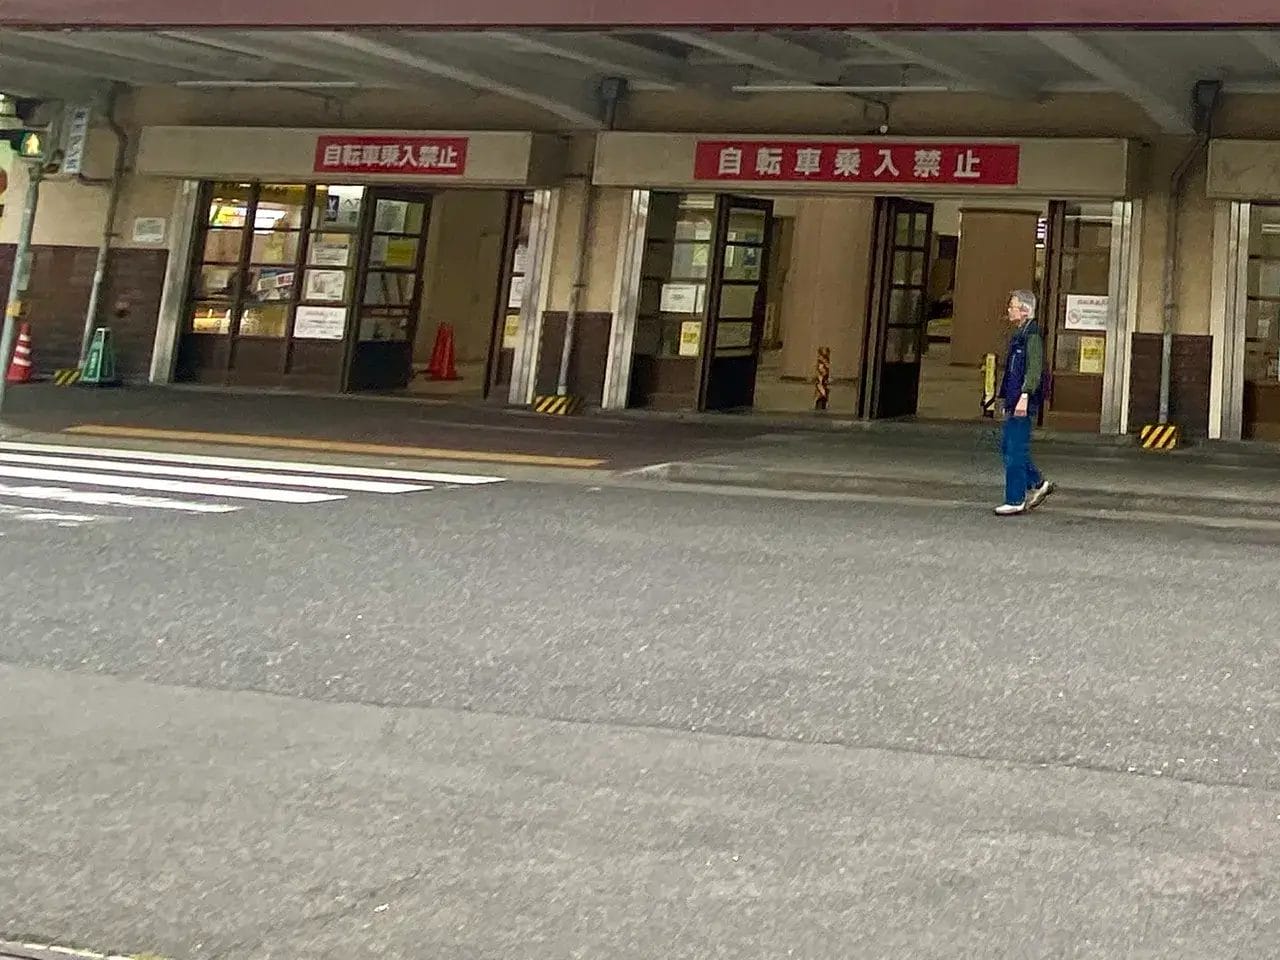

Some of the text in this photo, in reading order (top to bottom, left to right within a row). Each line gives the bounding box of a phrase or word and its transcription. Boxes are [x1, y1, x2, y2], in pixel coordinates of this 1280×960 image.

[324, 145, 457, 169] 自転車乗入禁止
[718, 147, 981, 178] 自転車乗入禁止
